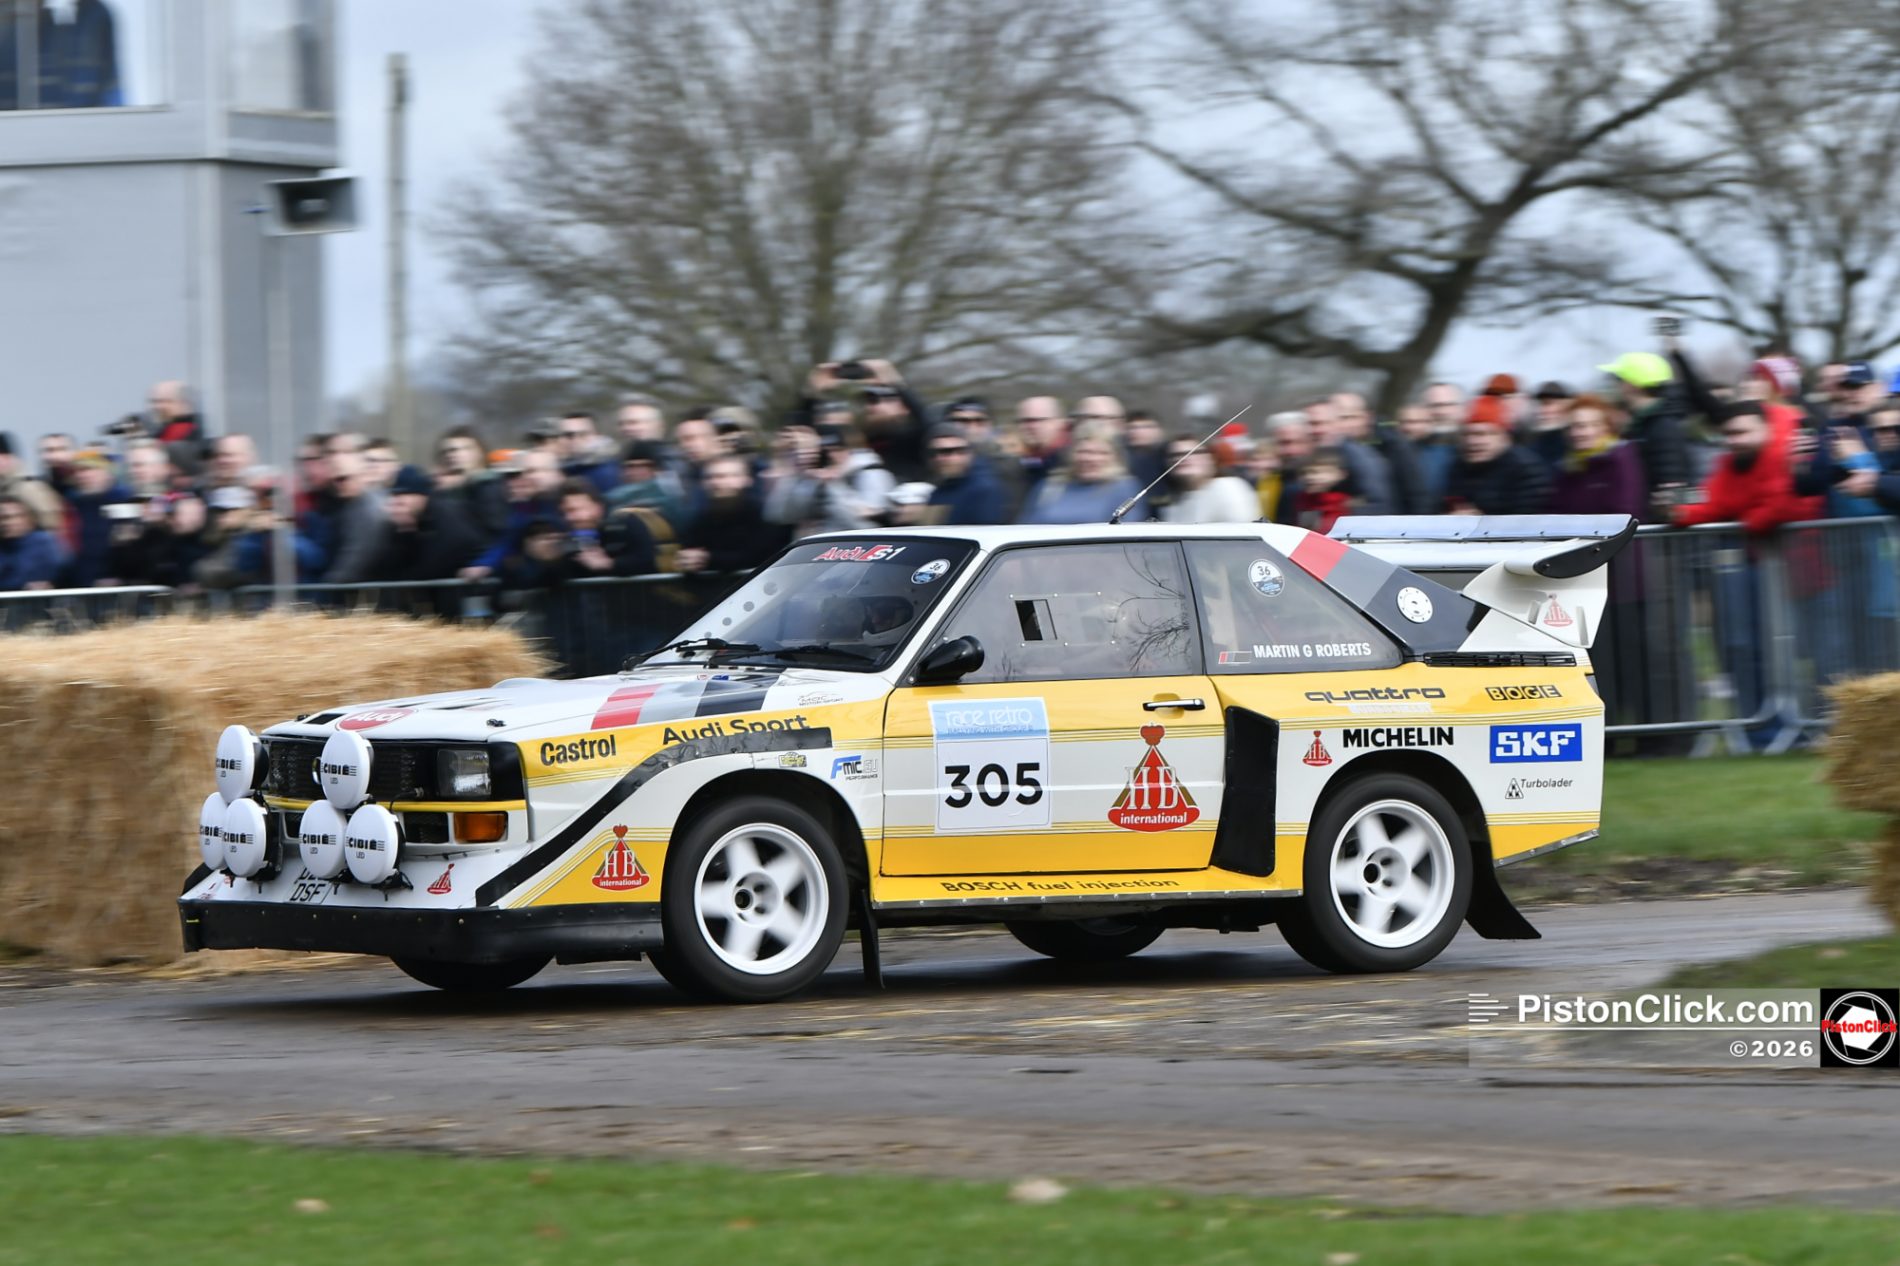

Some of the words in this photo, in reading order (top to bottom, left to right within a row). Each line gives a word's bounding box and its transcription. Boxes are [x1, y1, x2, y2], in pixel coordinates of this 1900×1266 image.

[1257, 565, 1271, 577] 36
[1253, 644, 1300, 659] MARTIN
[1302, 644, 1313, 658] G
[1315, 642, 1372, 657] ROBERTS
[1304, 687, 1446, 704] quattro
[1486, 685, 1562, 701] BOGE
[945, 709, 986, 727] race
[988, 706, 1033, 727] retro
[662, 721, 724, 745] Audi
[730, 715, 811, 734] Sport
[1342, 726, 1455, 749] MICHELIN
[540, 734, 617, 767] Castrol
[1495, 730, 1576, 757] SKF
[944, 762, 1043, 809] 305
[1124, 766, 1180, 810] HB
[1520, 778, 1574, 789] Turbolader
[1119, 811, 1188, 826] international
[603, 850, 638, 877] HB
[599, 876, 643, 888] international
[940, 882, 1024, 893] BOSCH
[1026, 881, 1073, 891] fuel
[1079, 879, 1180, 891] injection
[290, 883, 326, 902] DSF
